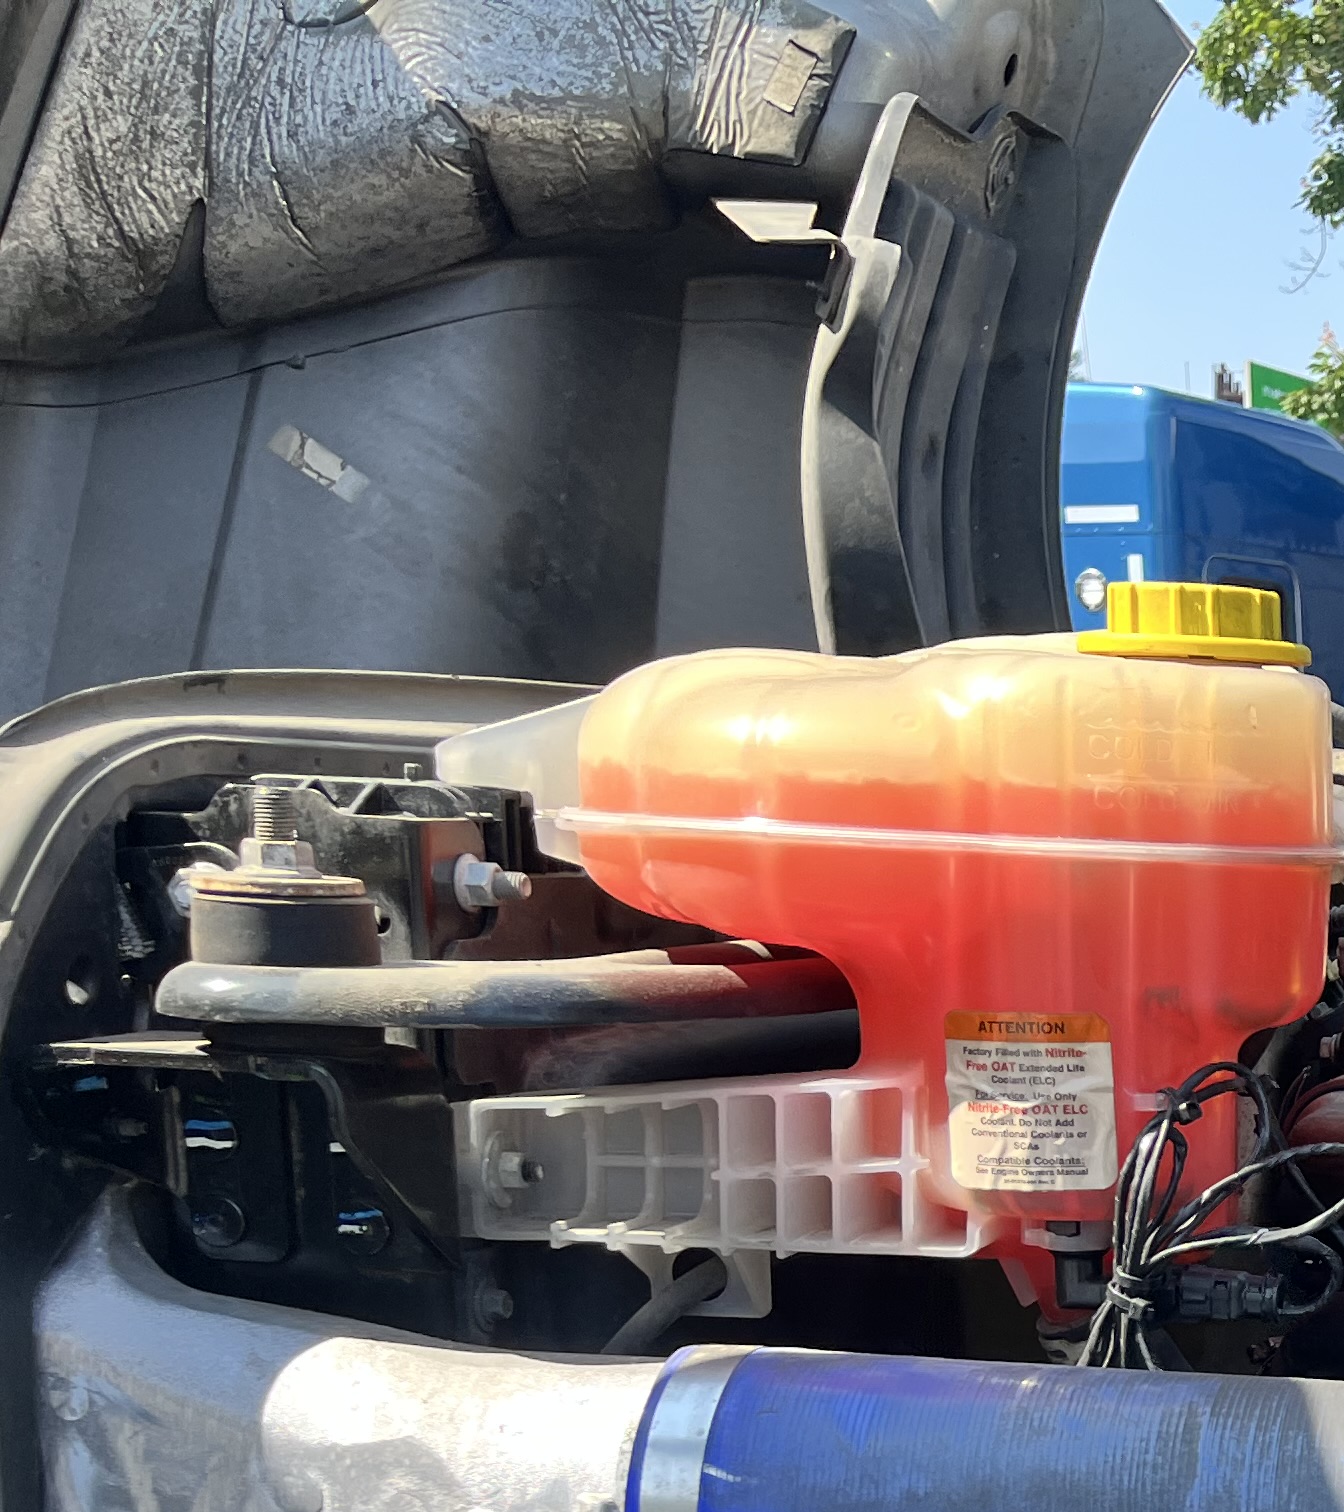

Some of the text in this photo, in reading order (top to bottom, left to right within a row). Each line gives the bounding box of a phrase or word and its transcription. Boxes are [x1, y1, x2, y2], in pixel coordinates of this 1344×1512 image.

[978, 1021, 1065, 1034] ATTENTION
[963, 1047, 1087, 1058] Factory Filled with Nitrite-
[966, 1060, 1085, 1073] Free OAT Extended Life
[991, 1075, 1056, 1086] Coolant (ELC)
[1055, 1093, 1077, 1101] Only
[968, 1103, 1088, 1115] Nitrite-Free OAT ELC
[1019, 1118, 1032, 1126] Do
[1035, 1118, 1051, 1126] Not
[1055, 1119, 1074, 1127] Add
[972, 1128, 1027, 1137] Conventional
[1031, 1130, 1074, 1139] Coolants
[1014, 1142, 1039, 1150] SCAs
[978, 1155, 1085, 1166] Compatible Coolants:
[991, 1167, 1018, 1175] Engine
[1057, 1168, 1088, 1176] Manual
